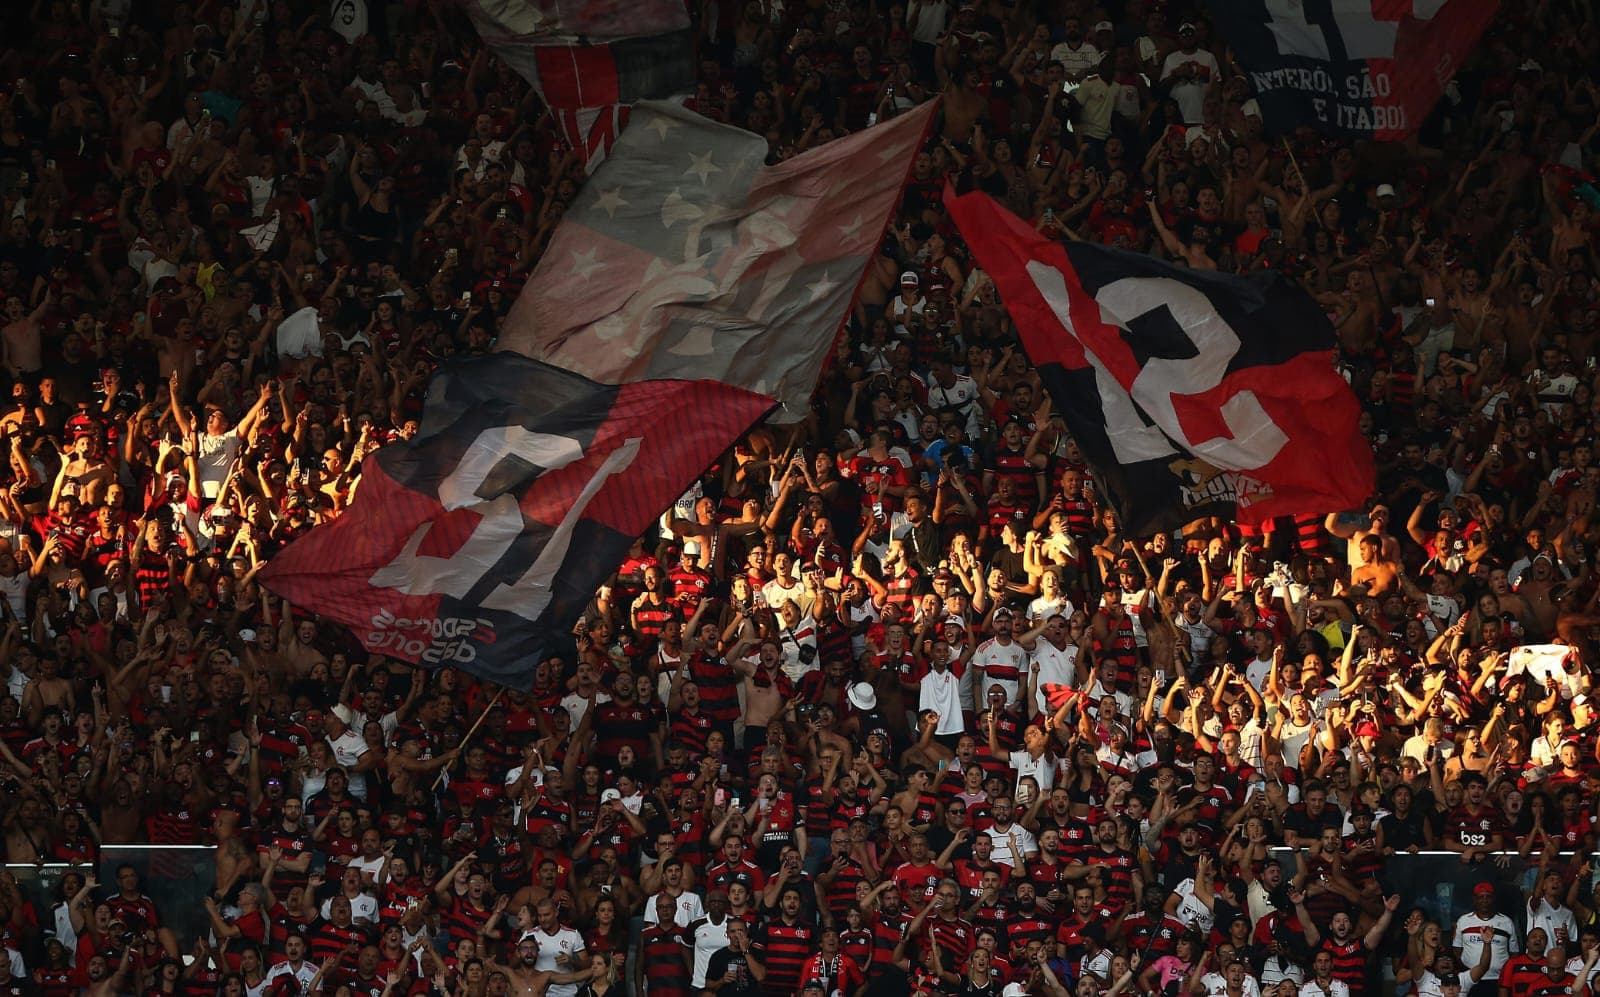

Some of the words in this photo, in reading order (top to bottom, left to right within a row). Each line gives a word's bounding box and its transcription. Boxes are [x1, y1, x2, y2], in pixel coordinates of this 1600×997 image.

[1345, 67, 1391, 99] SÃO
[1312, 98, 1328, 121] E
[1460, 830, 1486, 846] bs2
